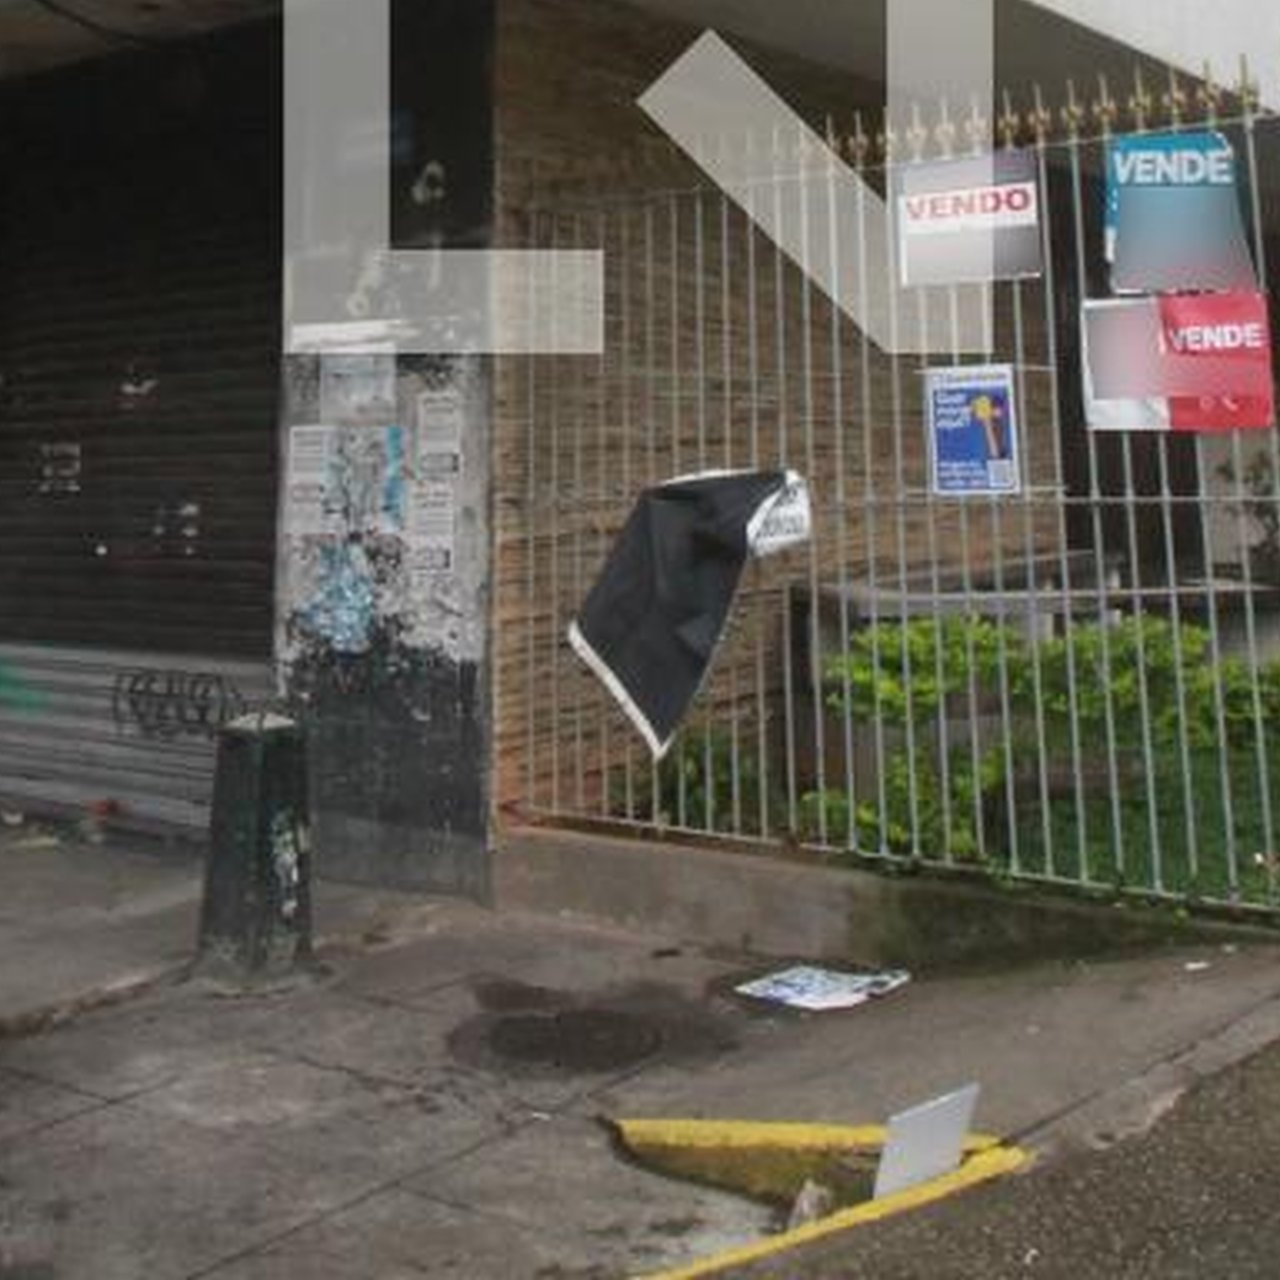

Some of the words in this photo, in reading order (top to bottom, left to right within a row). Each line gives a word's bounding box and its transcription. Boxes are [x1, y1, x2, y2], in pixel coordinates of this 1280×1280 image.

[1113, 149, 1233, 184] VENDE
[905, 188, 1030, 219] VENDO
[1168, 323, 1264, 351] VENDE
